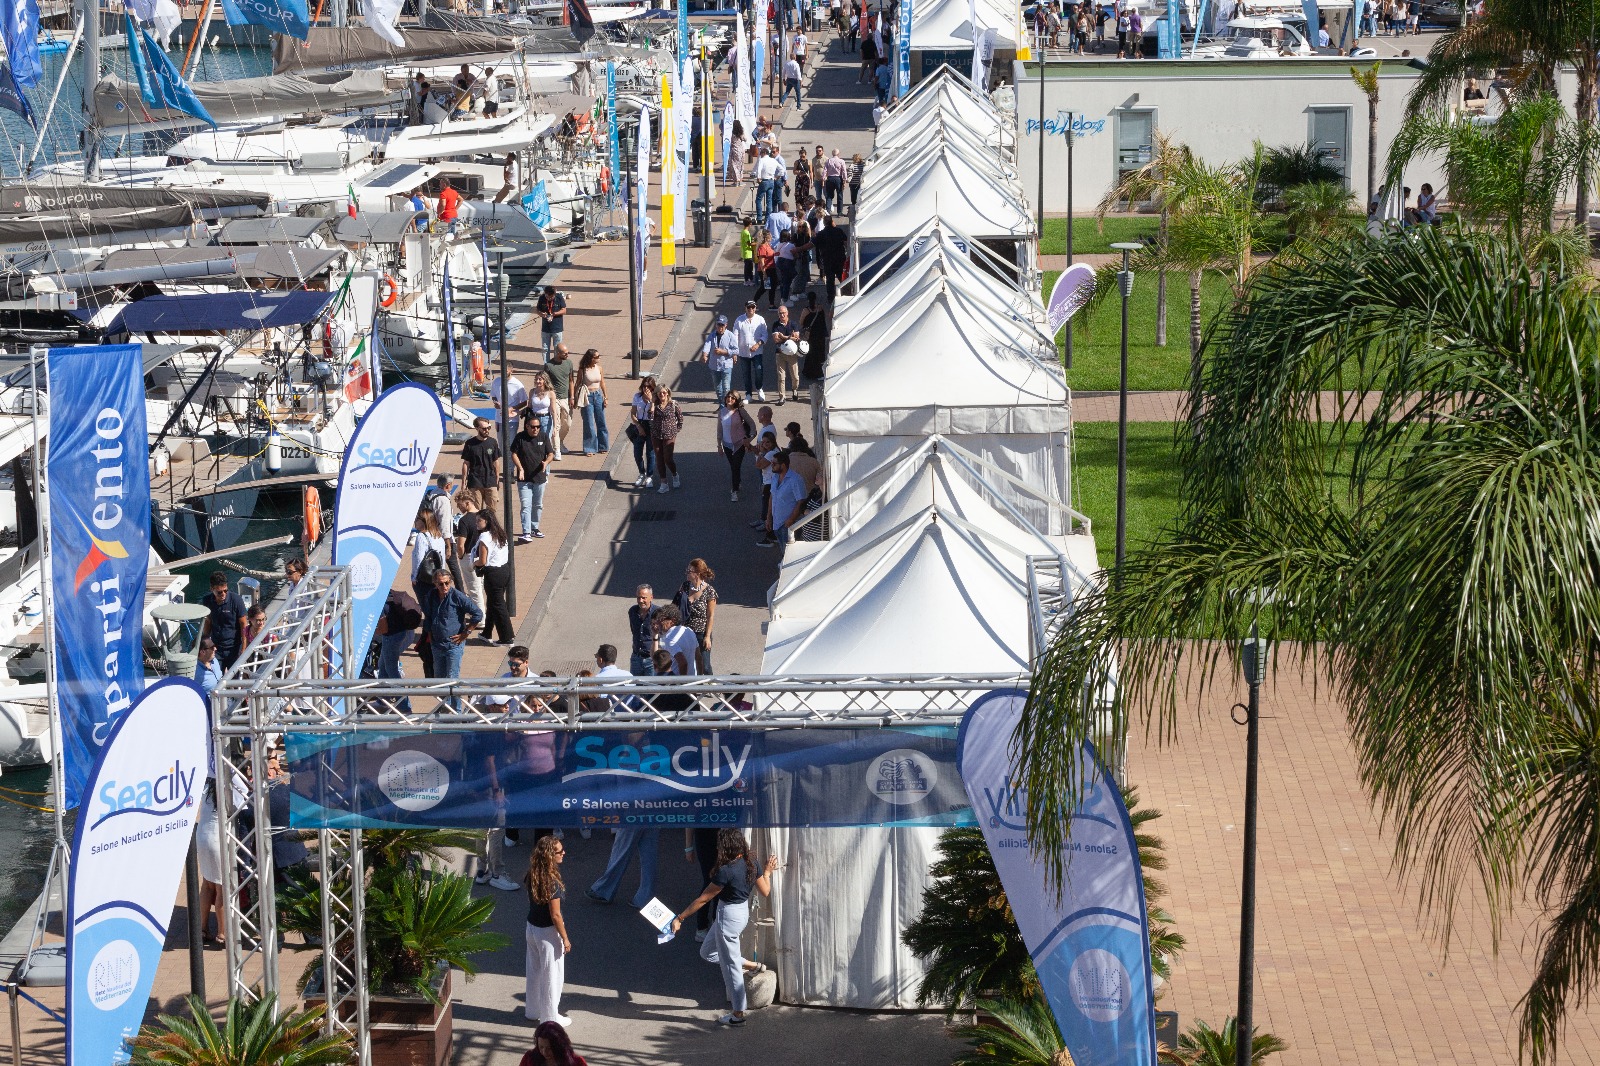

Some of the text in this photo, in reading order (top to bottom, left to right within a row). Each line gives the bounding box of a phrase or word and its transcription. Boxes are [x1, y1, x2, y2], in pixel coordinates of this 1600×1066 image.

[46, 193, 104, 207] DUFOUR
[356, 439, 430, 471] Seacily
[575, 732, 752, 779] Seacily
[98, 759, 196, 821] Seacily
[389, 792, 440, 801] Mediterraneo
[562, 798, 754, 809] 6° Salone Nautico di Sicilia
[581, 813, 737, 824] 19-22 OTTOBRE 2023
[91, 819, 188, 855] Salone Nautico di Sicilia
